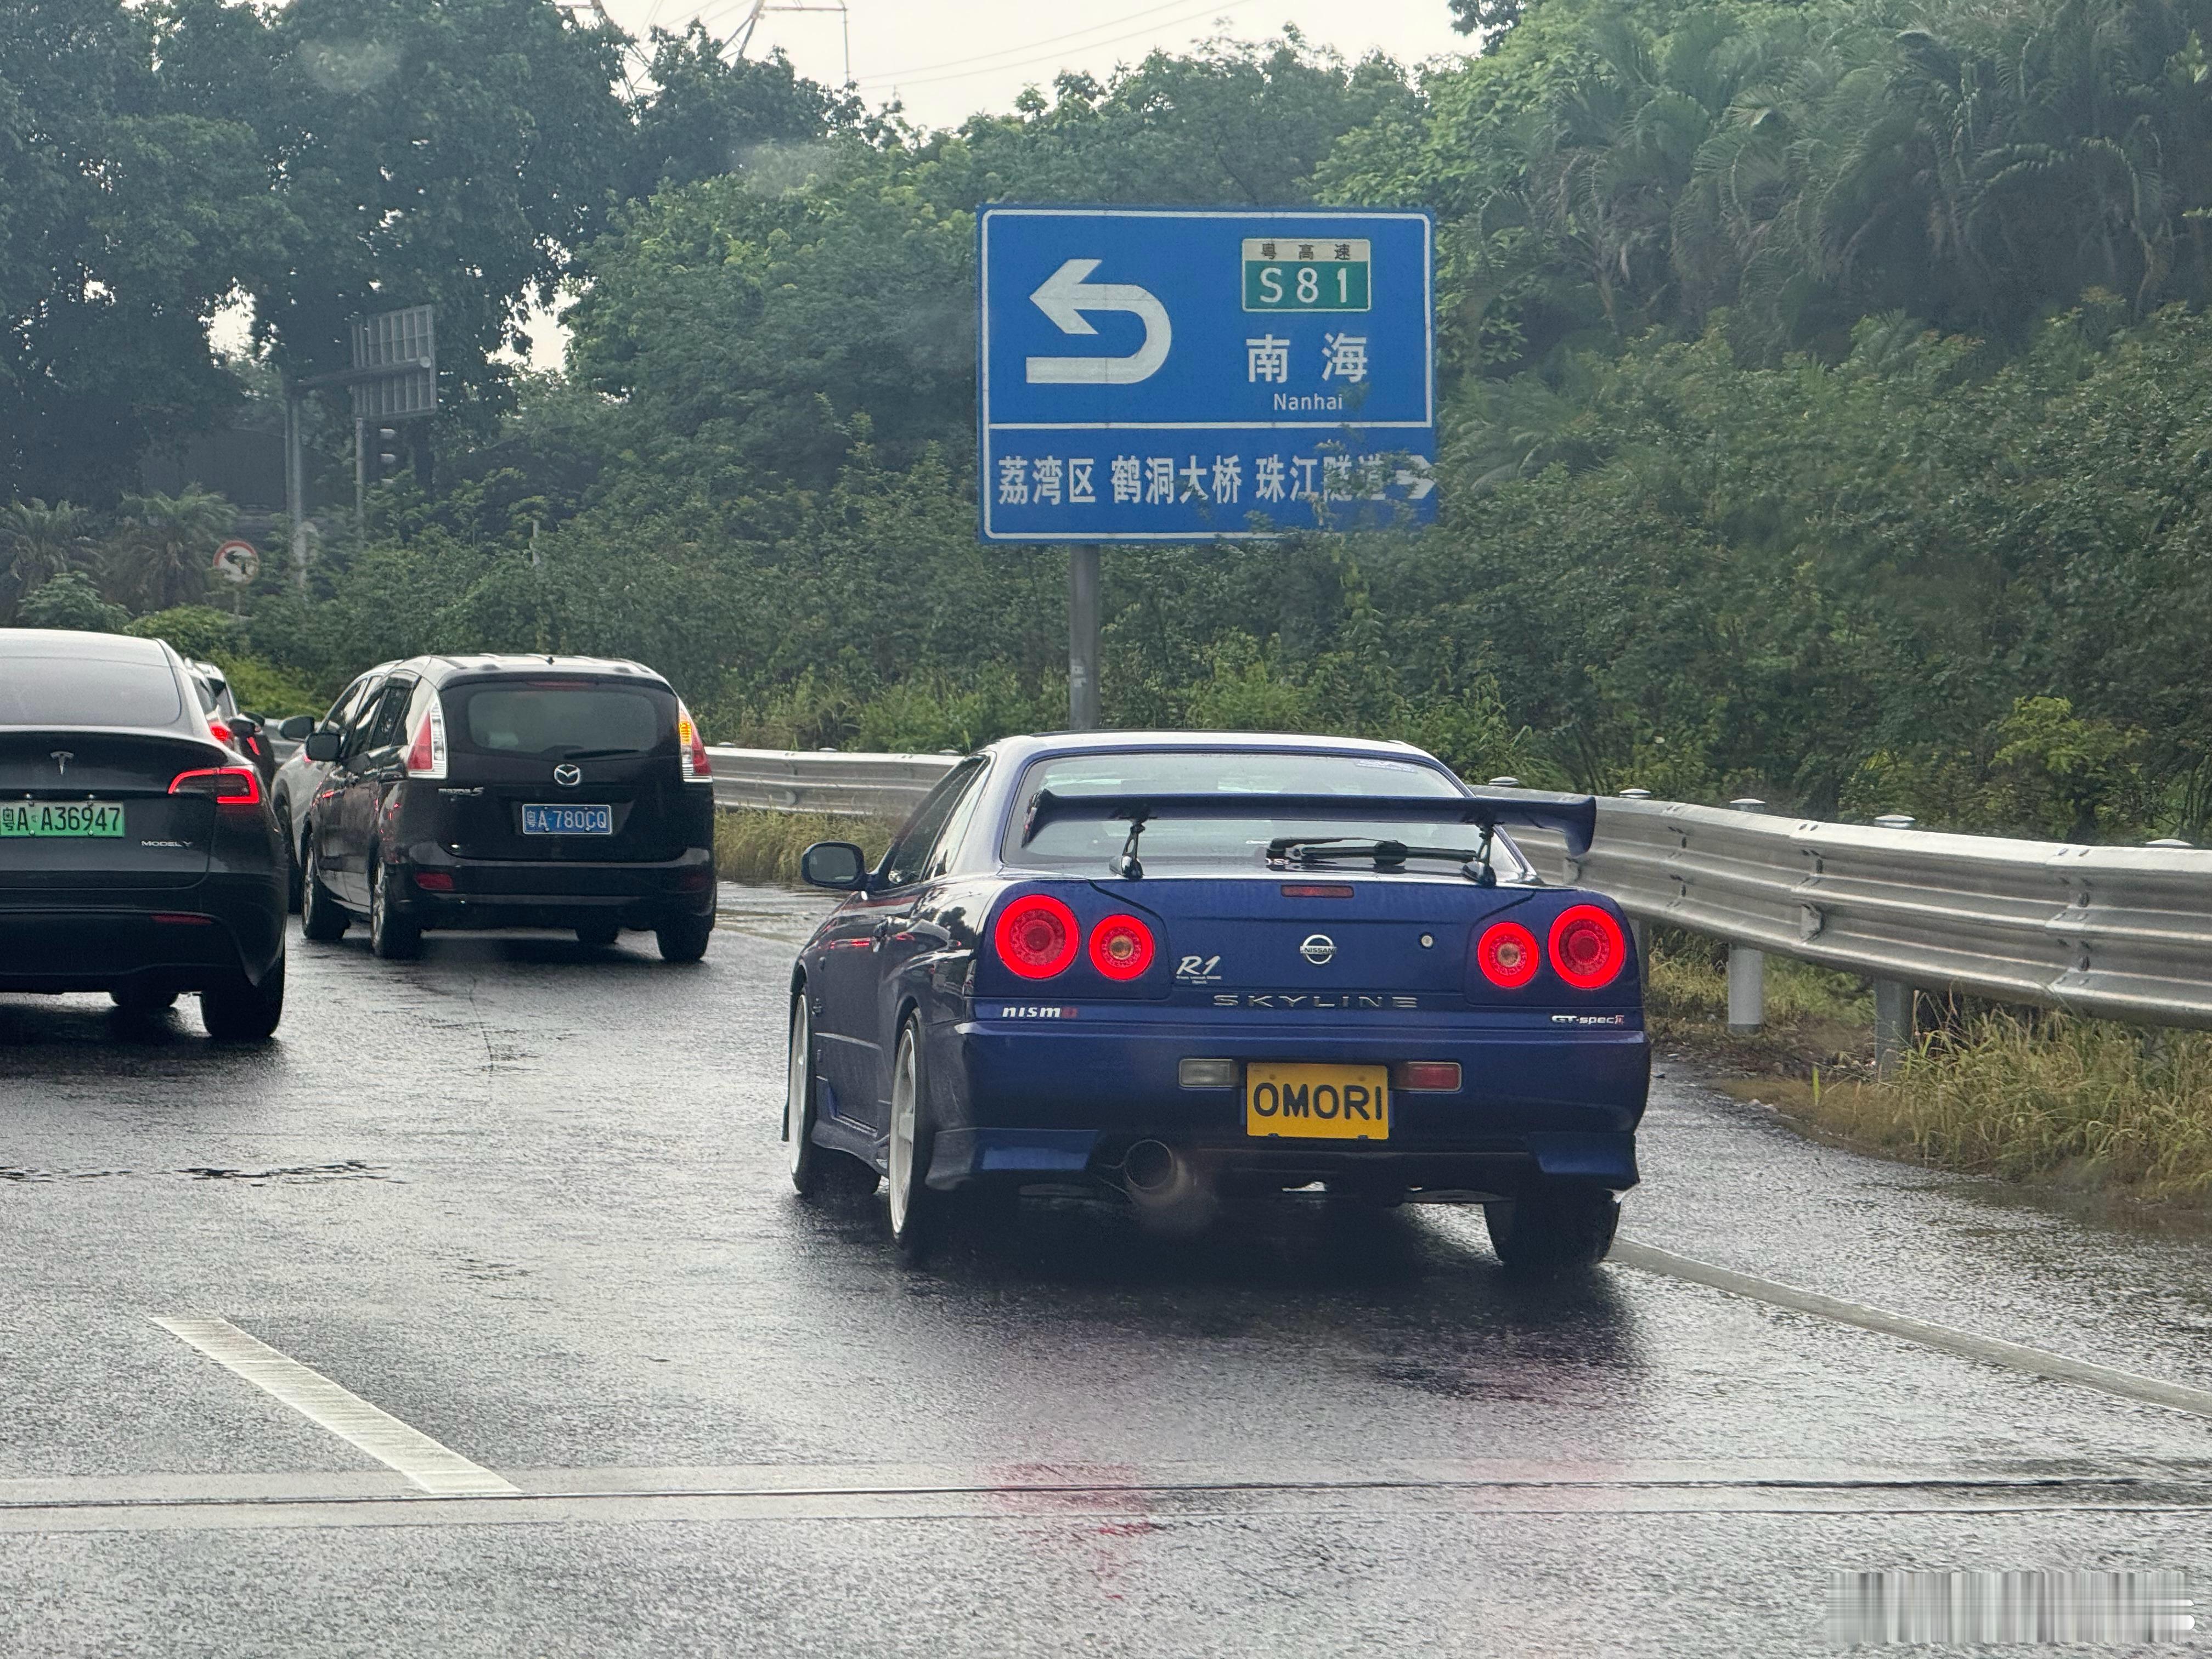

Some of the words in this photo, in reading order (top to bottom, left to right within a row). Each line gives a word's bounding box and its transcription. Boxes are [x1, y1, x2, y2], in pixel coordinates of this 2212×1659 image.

[1261, 243, 1351, 261] 粤高速
[1260, 267, 1347, 303] S81
[1246, 333, 1368, 383] 南海
[1273, 393, 1343, 411] Nanhai
[998, 455, 1096, 505] 荔湾区
[1110, 454, 1242, 505] 鹤洞大桥
[1176, 955, 1221, 975] R1
[1213, 995, 1418, 1008] SKYLINE
[1253, 1082, 1382, 1120] OMORI
